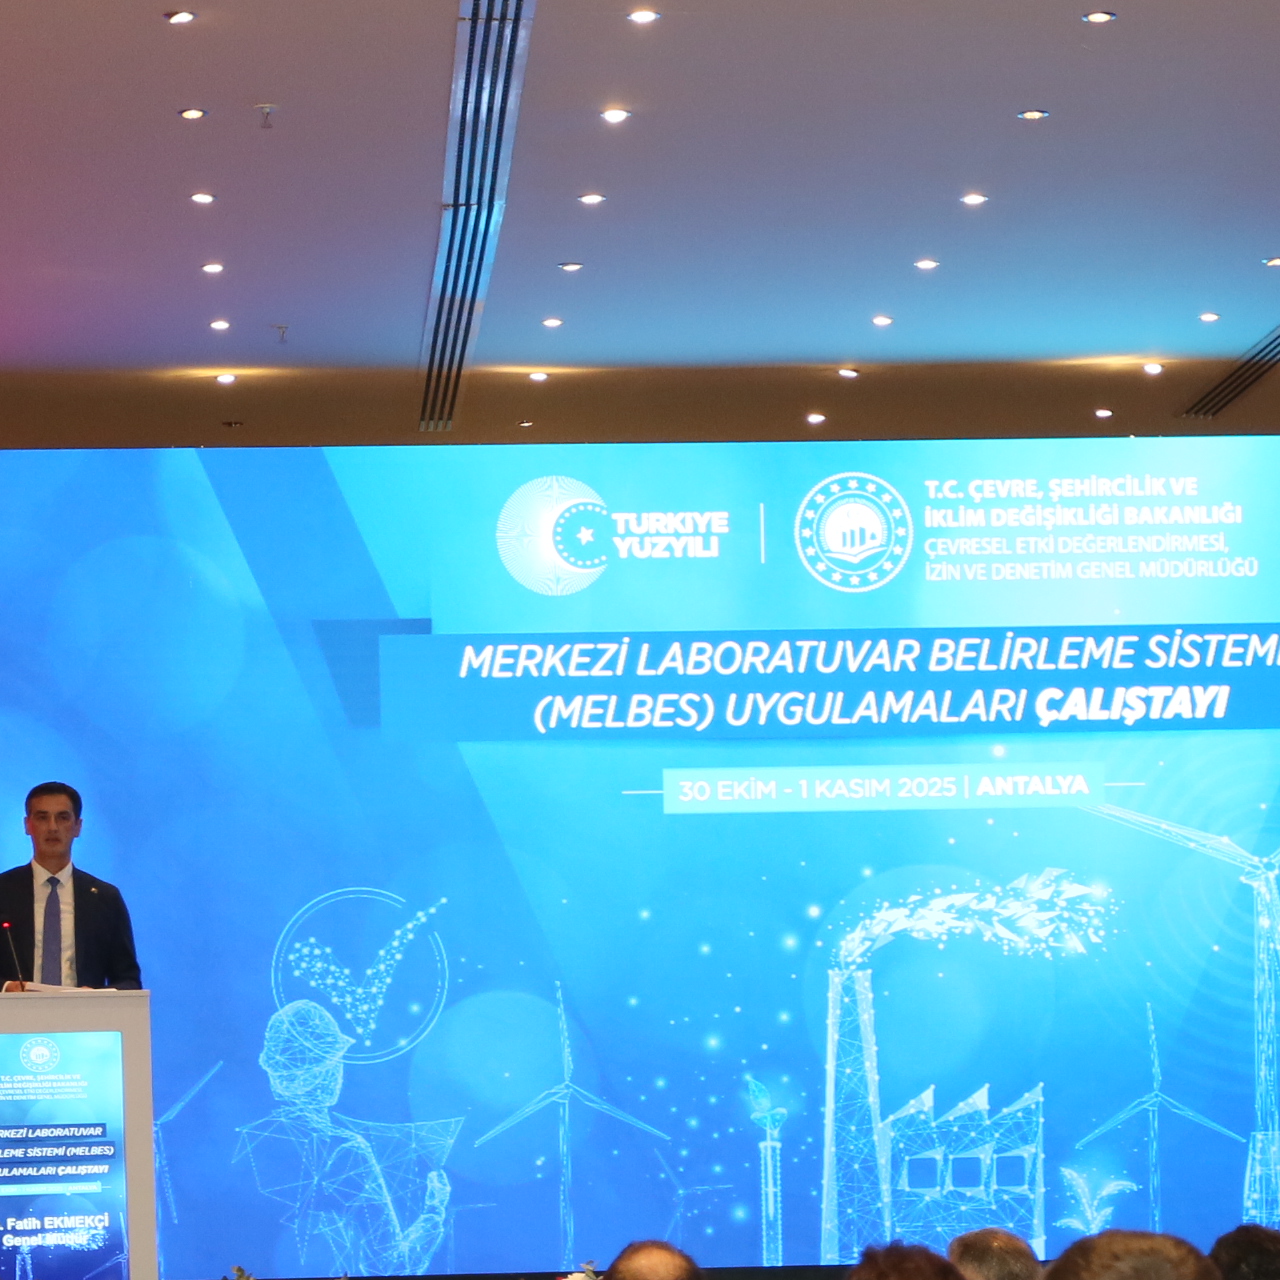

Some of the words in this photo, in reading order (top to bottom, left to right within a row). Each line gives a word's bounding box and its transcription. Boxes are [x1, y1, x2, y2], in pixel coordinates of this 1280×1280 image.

[924, 480, 965, 499] T.C.
[968, 479, 1044, 503] ÇEVRE,
[1048, 474, 1167, 502] ŞEHİRCİLİK
[1169, 476, 1198, 496] VE
[924, 505, 986, 528] İKLİM
[990, 503, 1119, 531] DEĞİŞİKLİĞİ
[1123, 501, 1242, 525] BAKANLIĞI
[924, 537, 1013, 560] ÇEVRESEL
[1015, 534, 1054, 554] ETKİ
[1057, 531, 1230, 555] DEĞERLENDİRMESİ,
[925, 561, 961, 581] İZİN
[963, 563, 988, 581] VE
[991, 560, 1073, 581] DENETİM
[1076, 561, 1136, 579] GENEL
[1139, 557, 1259, 578] MÜDÜRLÜĞÜ
[459, 637, 630, 678] MERKEZİ
[636, 639, 921, 676] LABORATUVAR
[927, 631, 1139, 673] BELİRLEME
[533, 692, 716, 735] (MELBES)
[725, 688, 1028, 727] UYGULAMALARI
[1034, 685, 1231, 728] ÇALIŞTAYI
[678, 780, 712, 801] 30
[716, 776, 776, 801] EKİM
[814, 777, 892, 800] KASIM
[897, 776, 957, 798] 2025
[976, 774, 1090, 797] ANTALYA
[28, 1126, 103, 1137] LABORATUVAR
[26, 1146, 66, 1157] SİSTEMİ
[66, 1145, 114, 1157] (MELBES)
[57, 1165, 109, 1176] ÇALIŞTAYI
[6, 1217, 41, 1230] Fatih
[44, 1212, 109, 1230] EKMEKÇİ
[2, 1233, 42, 1246] Genel
[45, 1231, 89, 1245] Müdür
